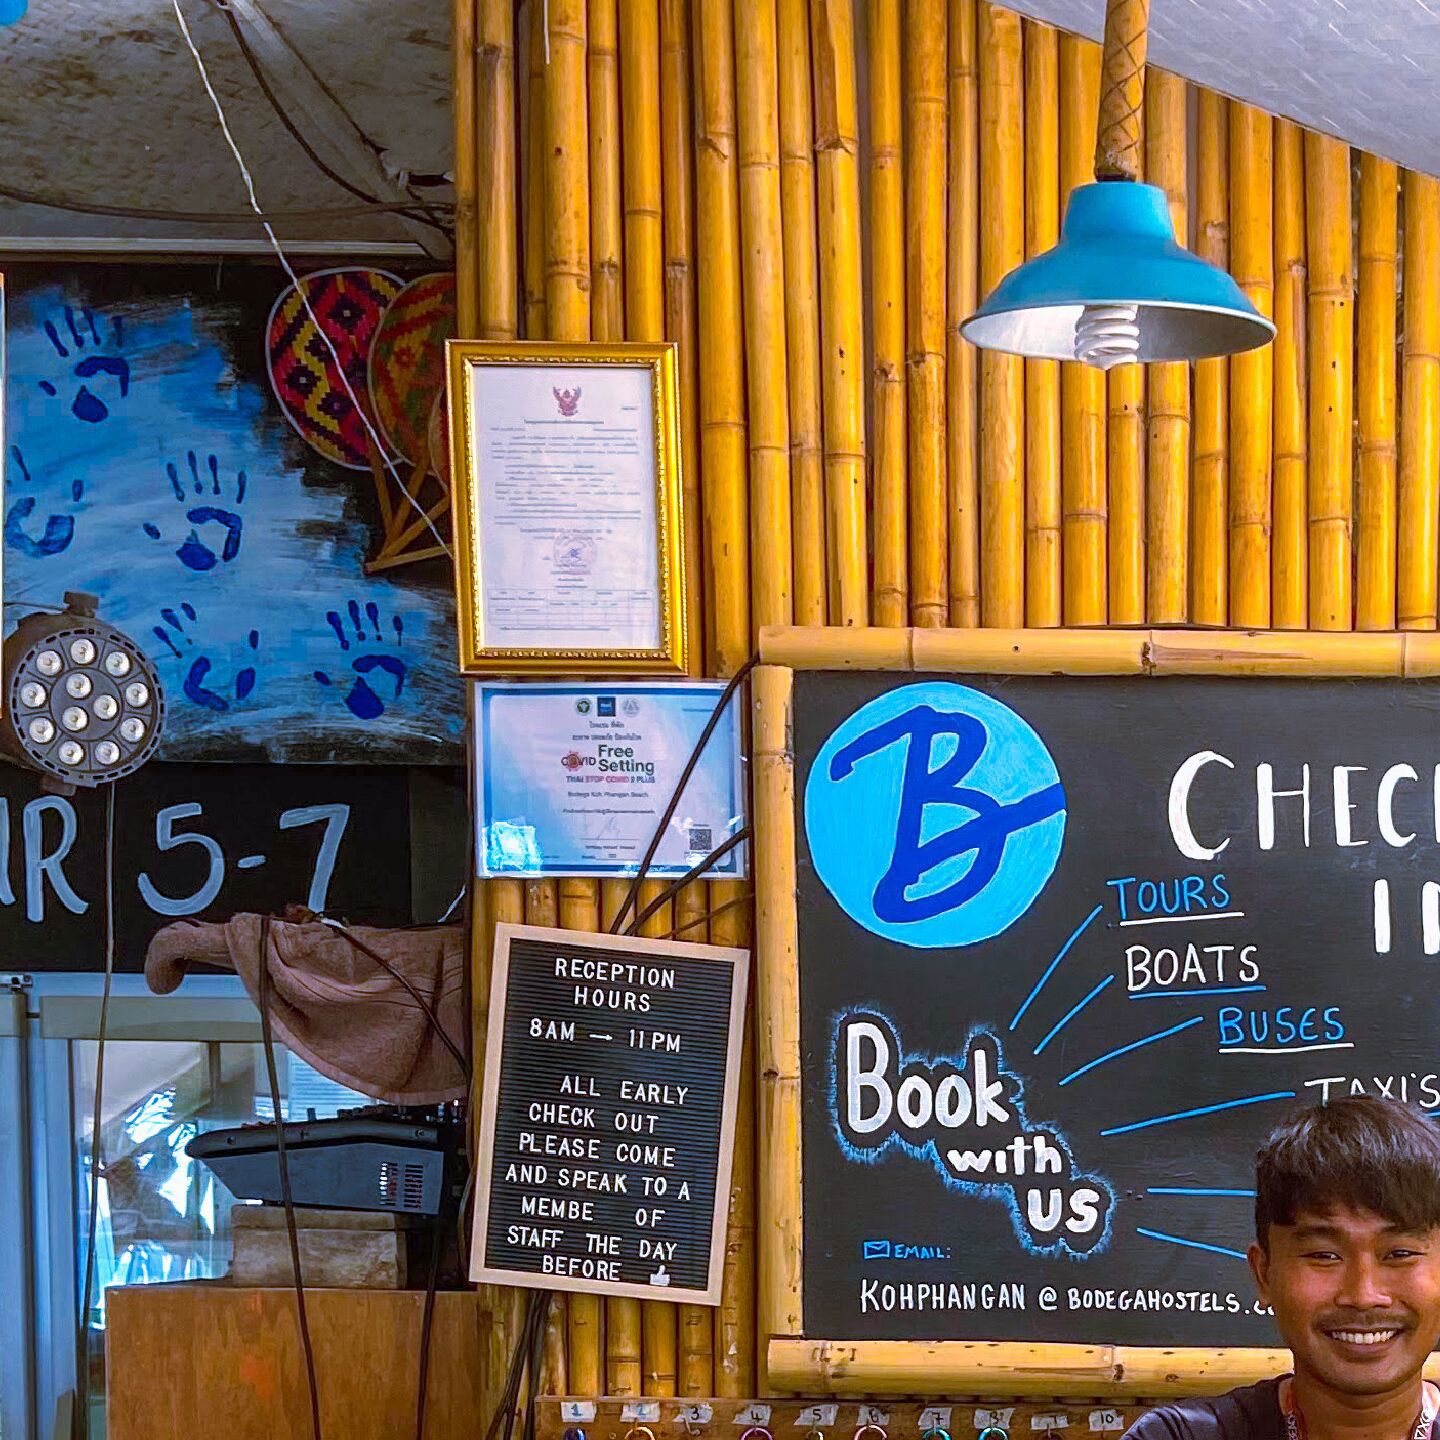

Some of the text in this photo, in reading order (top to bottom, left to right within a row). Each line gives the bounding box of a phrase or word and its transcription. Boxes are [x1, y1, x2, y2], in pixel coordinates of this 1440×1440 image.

[598, 744, 634, 758] Free
[598, 759, 655, 775] Setting
[137, 802, 350, 916] 5-7
[1107, 873, 1231, 920] TOURS
[555, 957, 675, 989] RECEPTION
[1125, 942, 1261, 992] BOATS
[574, 985, 650, 1012] HOURS
[529, 1017, 575, 1042] 8AM
[1218, 1006, 1346, 1045] BUSES
[560, 1075, 689, 1105] ALL EARLY
[847, 1022, 1010, 1133] Book
[529, 1102, 660, 1134] CHECK OUT
[519, 1132, 676, 1167] PLEASE COME
[947, 1136, 1063, 1175] with
[505, 1163, 690, 1200] AND SPEAK TO A
[521, 1196, 666, 1228] MEMBE OF
[507, 1225, 678, 1260] STAFF THE DAY
[542, 1254, 623, 1281] BEFORE
[859, 1278, 1275, 1316] KOHPHANGAN @ BODEGAHOSTELS.C
[691, 1406, 700, 1420] 3
[751, 1410, 763, 1422] 4
[812, 1408, 822, 1421] 5
[931, 1411, 944, 1424] 7
[1101, 1411, 1115, 1425] 10
